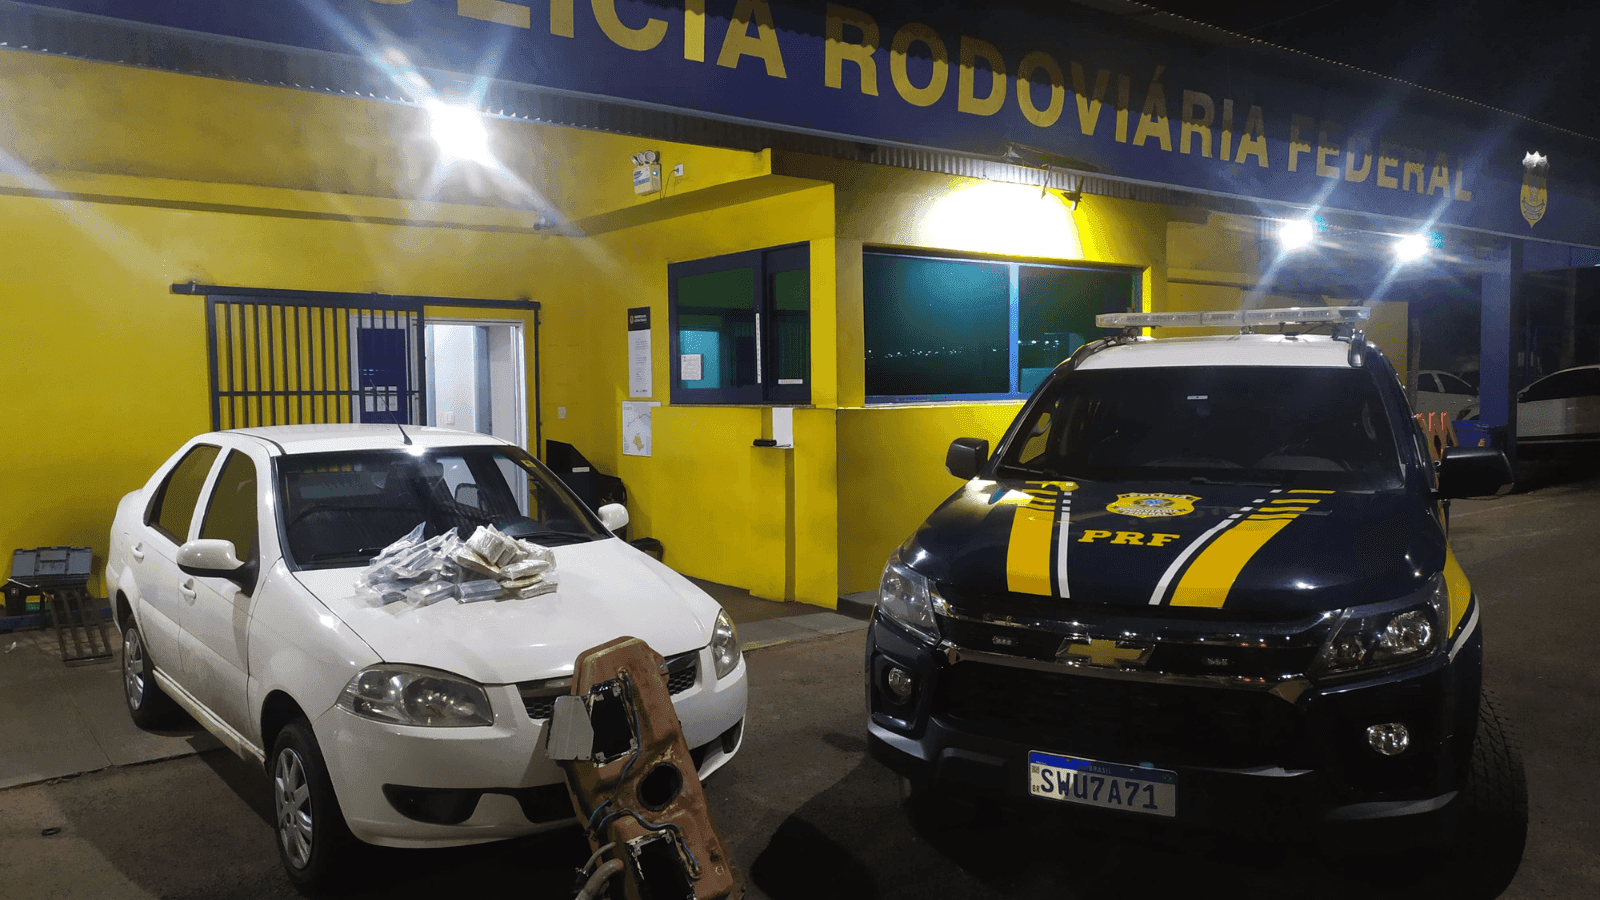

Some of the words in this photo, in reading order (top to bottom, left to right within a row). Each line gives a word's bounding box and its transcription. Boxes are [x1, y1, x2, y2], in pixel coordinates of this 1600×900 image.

[823, 2, 1269, 169] RODOVIÁRIA
[1287, 113, 1472, 202] FEDERAL
[1077, 529, 1180, 547] PRF
[1088, 765, 1112, 775] BRASIL
[1040, 768, 1159, 810] SWU7A71
